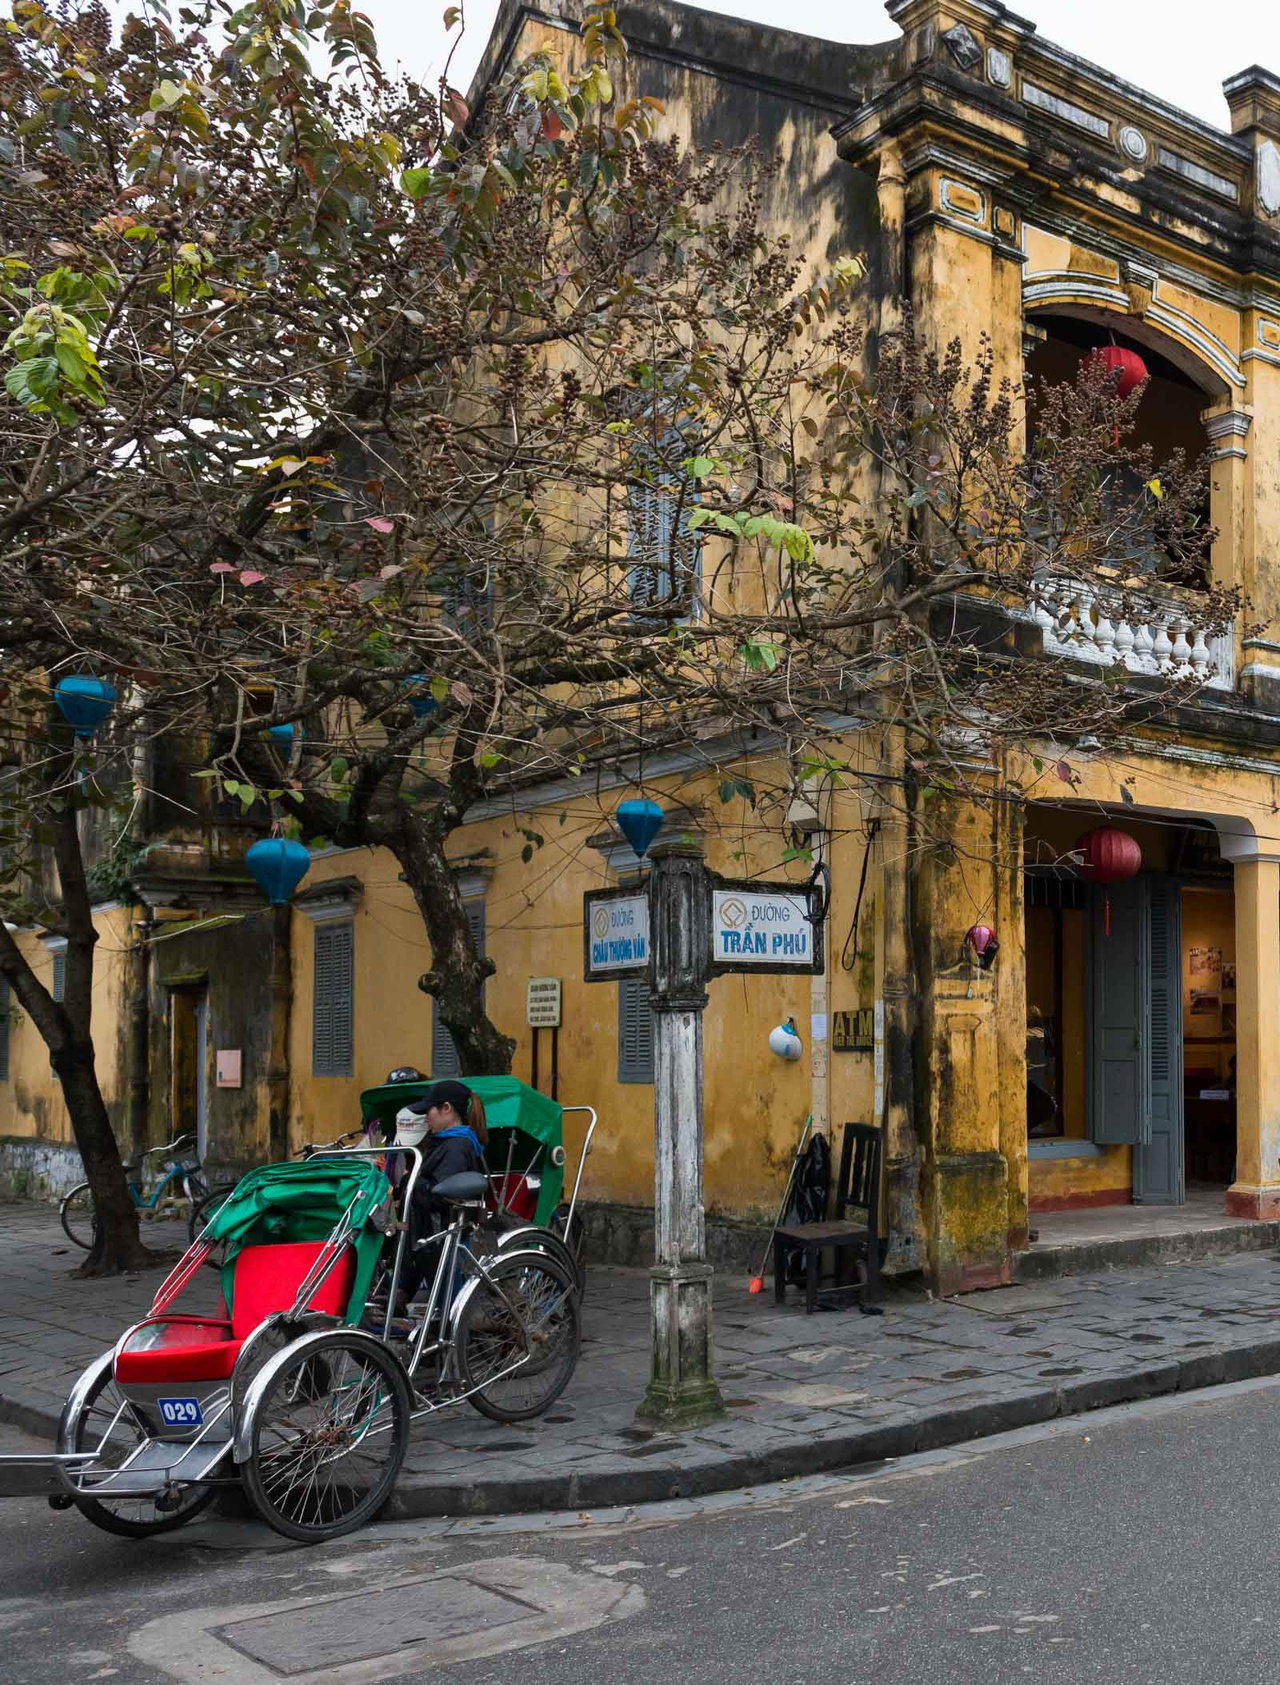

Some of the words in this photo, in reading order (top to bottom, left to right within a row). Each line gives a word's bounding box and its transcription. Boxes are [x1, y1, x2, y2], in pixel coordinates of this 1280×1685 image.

[752, 902, 790, 922] ĐƯỜNG
[720, 922, 767, 954] TRẦN
[772, 928, 807, 955] PHÚ
[834, 1011, 873, 1036] ATM
[163, 1402, 197, 1421] 029
